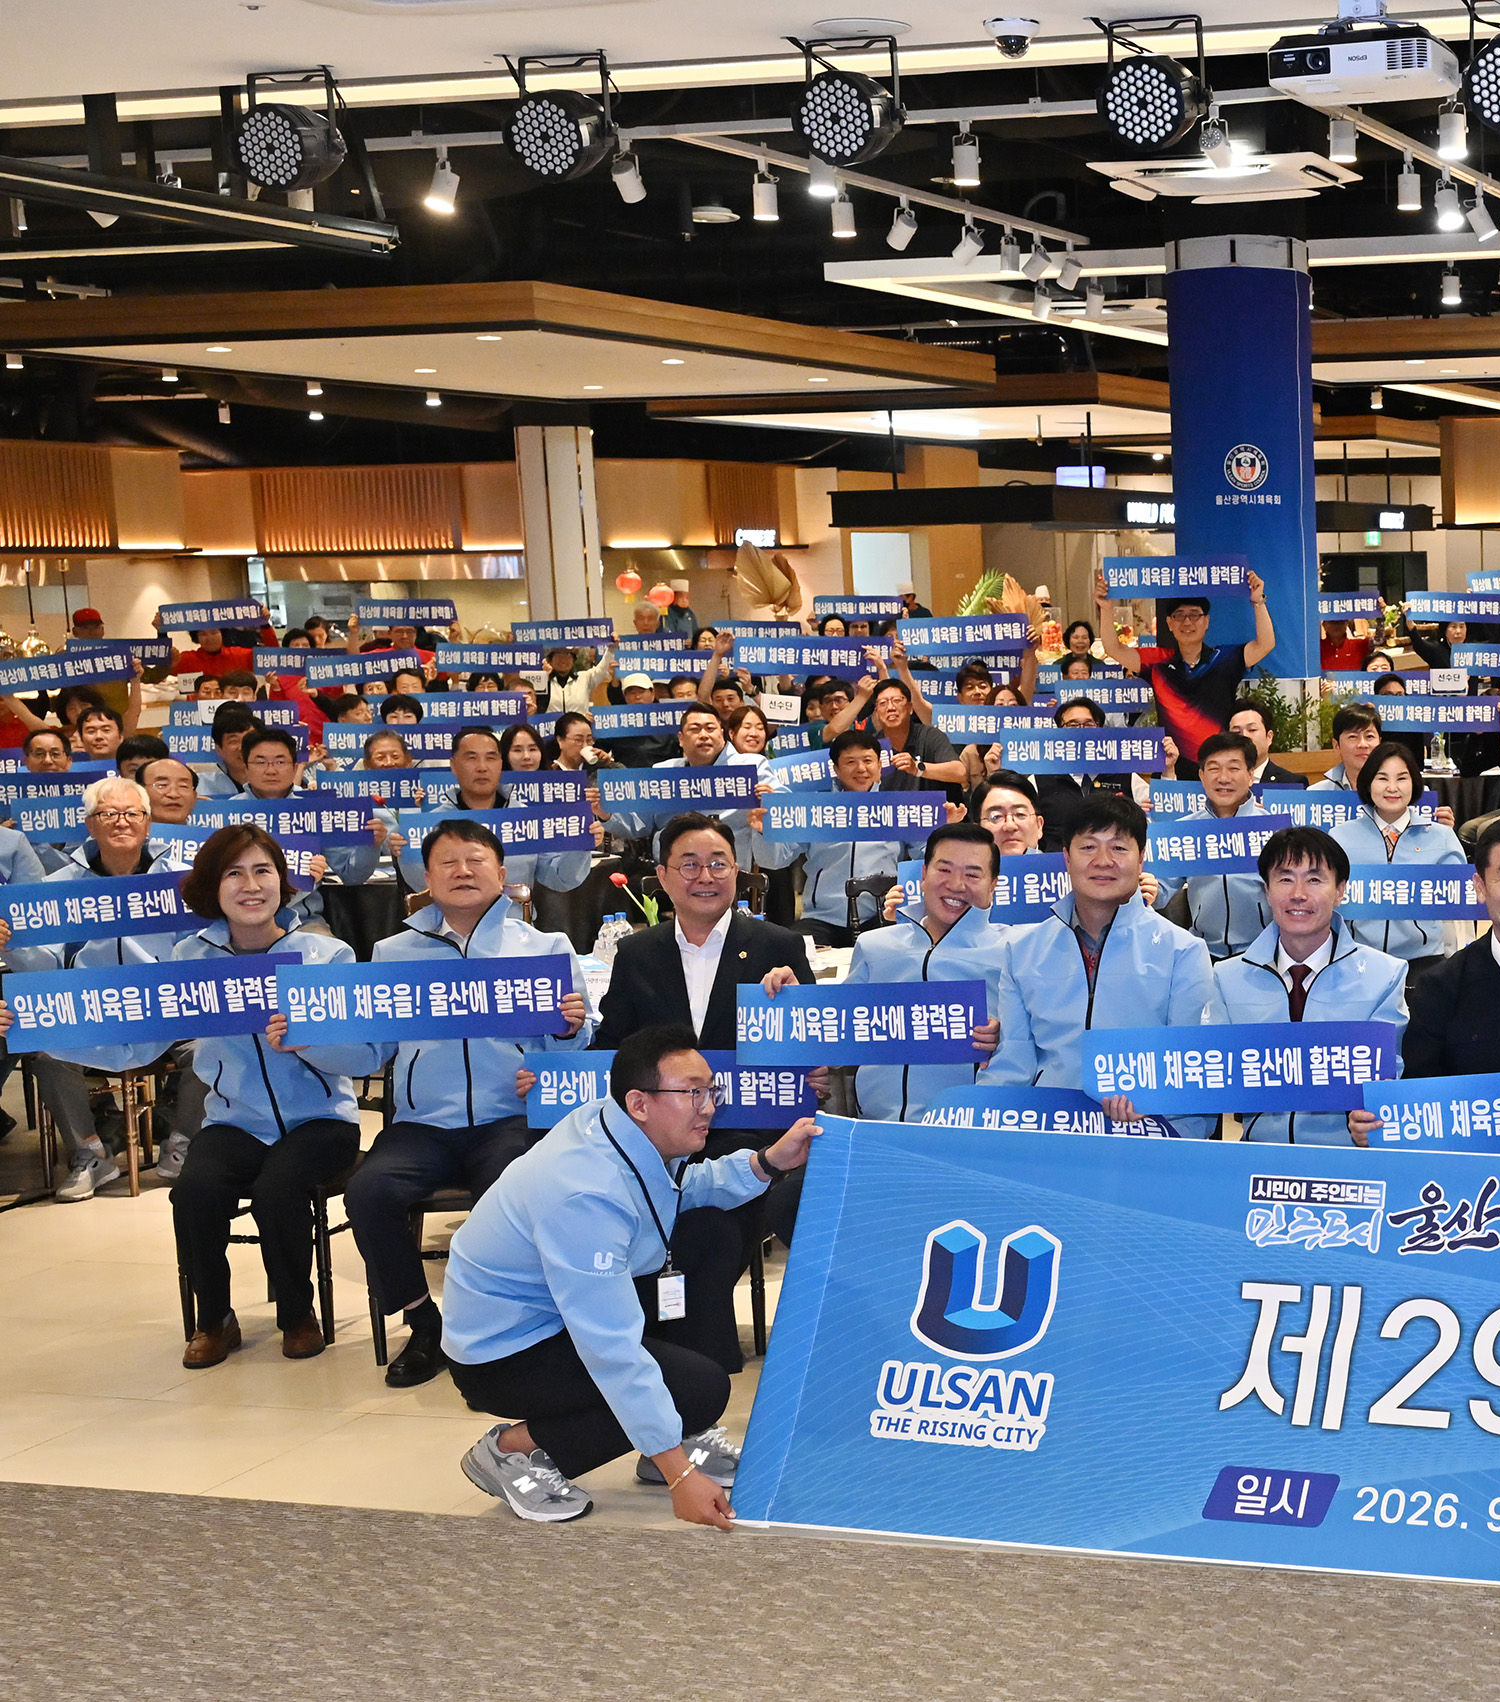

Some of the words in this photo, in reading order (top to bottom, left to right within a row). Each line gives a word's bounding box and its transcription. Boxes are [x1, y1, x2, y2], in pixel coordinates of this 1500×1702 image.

[1348, 54, 1368, 62] EPSON
[1216, 494, 1282, 506] 울산광역시체육회
[1108, 568, 1138, 587] 일상에
[1141, 568, 1174, 585] 체육을!
[1178, 567, 1207, 585] 울산에
[1211, 566, 1244, 584] 활력을!
[162, 611, 184, 624] 일상에
[185, 609, 210, 622] 체육을!
[212, 608, 234, 621] 울산에
[235, 604, 260, 619] 활력을!
[1409, 599, 1431, 612] 일상에
[1432, 600, 1455, 613] 체육을!
[1457, 601, 1477, 614] 울산에
[516, 629, 536, 641] 일상에
[538, 628, 561, 640] 체육을!
[564, 626, 585, 639] 울산에
[586, 625, 612, 638] 활력을!
[902, 628, 929, 645] 일상에
[931, 627, 962, 643] 체육을!
[965, 625, 992, 642] 울산에
[994, 623, 1027, 640] 활력을!
[739, 646, 766, 662] 일상에
[769, 648, 799, 664] 체육을!
[802, 649, 828, 665] 울산에
[831, 650, 861, 666] 활력을!
[1454, 652, 1473, 666] 일상에
[1475, 652, 1500, 667] 체육을!
[1438, 672, 1461, 682] 선수단
[768, 700, 793, 711] 선수단
[1378, 705, 1403, 721] 일상에
[1406, 706, 1435, 722] 체육을!
[1438, 706, 1463, 722] 울산에
[1466, 706, 1498, 722] 활력을!
[1007, 741, 1040, 761] 일상에
[1044, 741, 1081, 760] 체육을!
[1085, 740, 1117, 760] 울산에
[1121, 740, 1158, 760] 활력을!
[603, 781, 636, 801] 일상에
[639, 780, 675, 799] 체육을!
[679, 779, 712, 798] 울산에
[714, 777, 751, 797] 활력을!
[770, 806, 806, 828] 일상에
[811, 806, 852, 827] 체육을!
[857, 806, 893, 827] 울산에
[897, 805, 938, 827] 활력을!
[10, 900, 60, 930] 일상에
[66, 896, 120, 926] 체육을!
[127, 891, 175, 920] 울산에
[14, 992, 76, 1029] 일상에
[83, 986, 151, 1023] 체육을!
[158, 982, 218, 1018] 울산에
[288, 987, 347, 1024] 일상에
[354, 984, 420, 1018] 체육을!
[429, 981, 488, 1016] 울산에
[494, 978, 565, 1013] 활력을!
[1095, 1053, 1156, 1091] 일상에
[1164, 1051, 1232, 1088] 체육을!
[1242, 1048, 1302, 1086] 울산에
[1310, 1046, 1381, 1084] 활력을!
[1376, 1103, 1443, 1140] 일상에
[1254, 1180, 1306, 1200] 시민이
[1310, 1182, 1381, 1204] 주인되는
[883, 1366, 1048, 1417] ULSAN
[876, 1416, 912, 1433] THE
[917, 1420, 987, 1440] RISING
[992, 1426, 1039, 1445] CITY
[688, 1448, 710, 1466] N
[512, 1475, 537, 1494] N
[1235, 1474, 1311, 1519] 일시
[1353, 1486, 1468, 1530] 2026.
